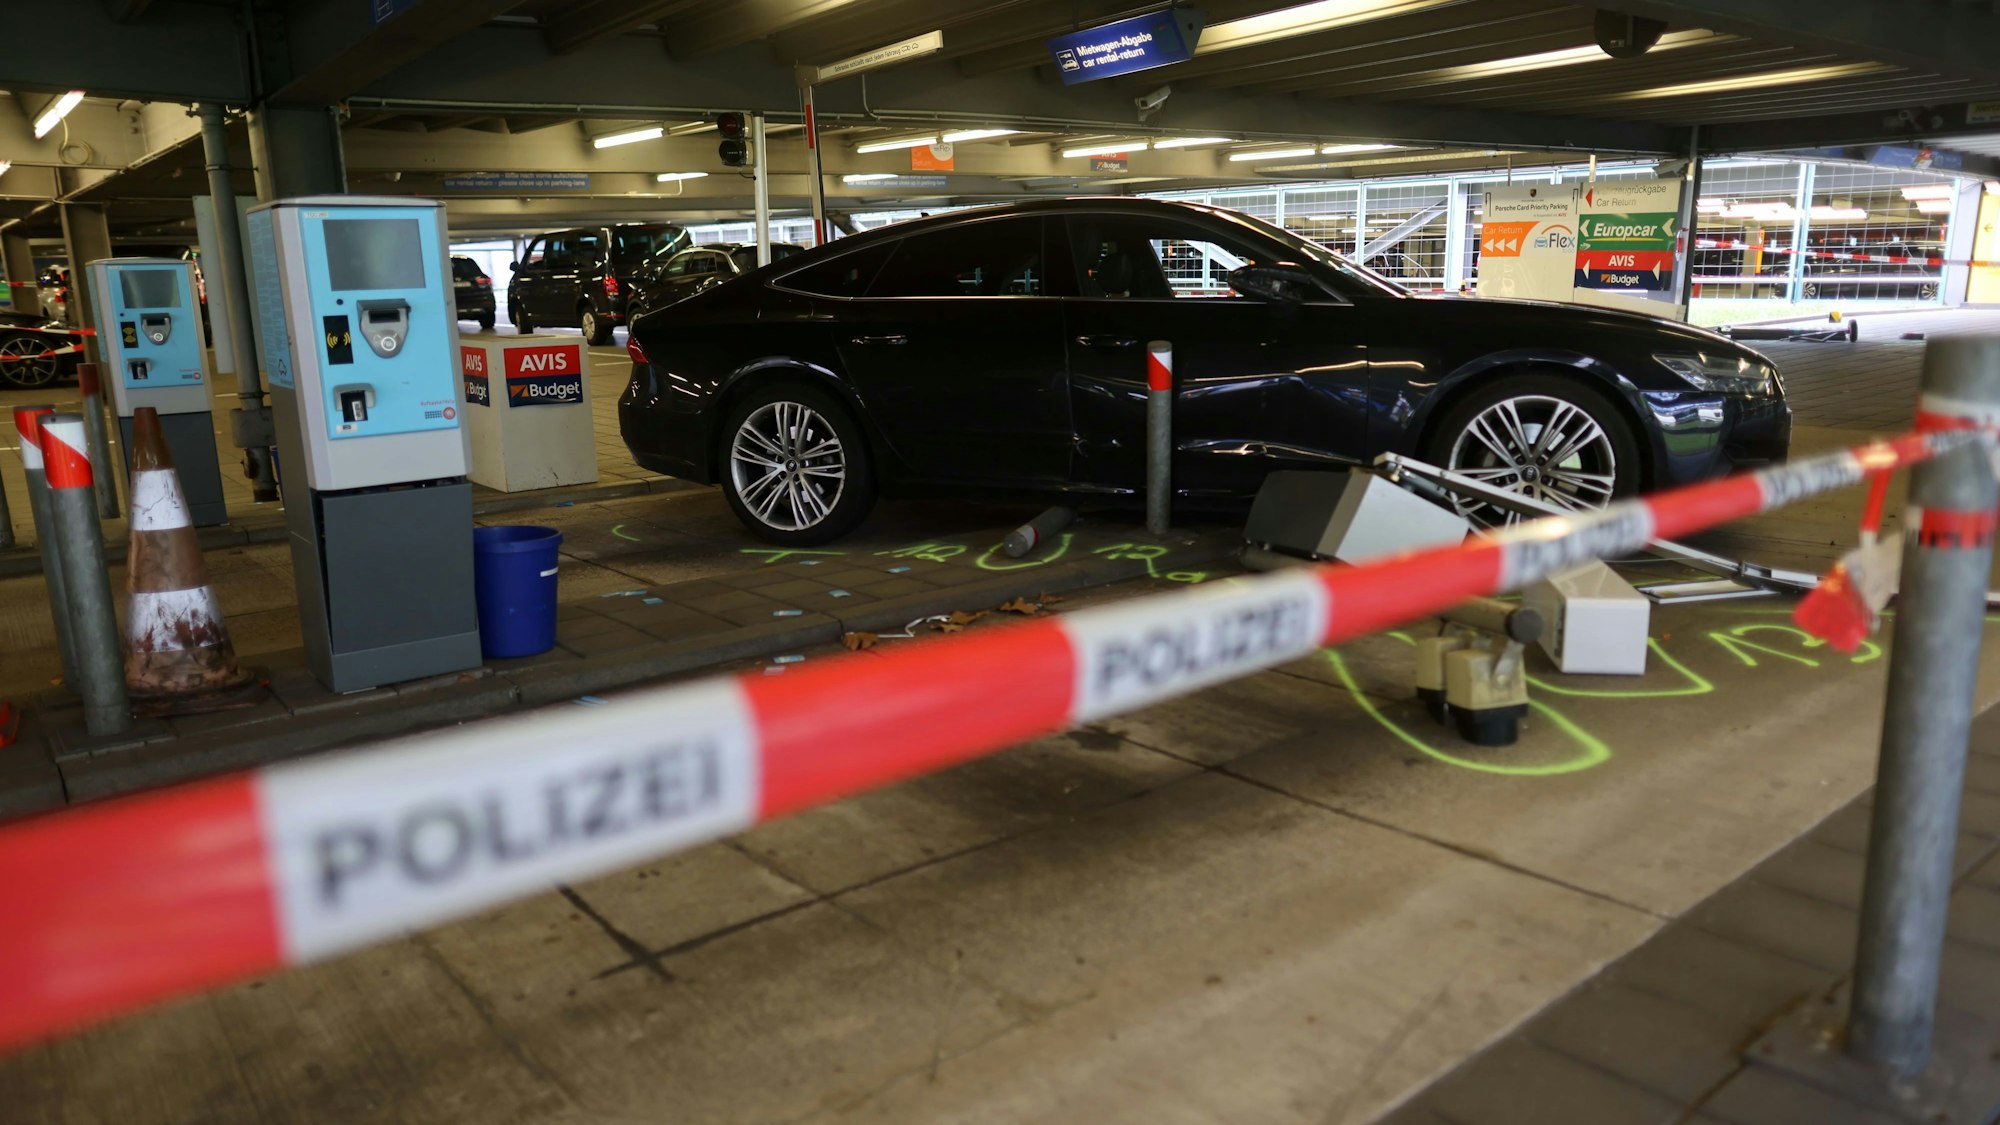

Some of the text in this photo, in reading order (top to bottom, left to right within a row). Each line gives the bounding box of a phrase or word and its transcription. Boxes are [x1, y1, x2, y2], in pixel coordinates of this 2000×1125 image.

[1076, 32, 1153, 56] Mietwagen-Abgabe
[884, 48, 901, 58] Fahrzeug
[1082, 47, 1146, 68] car rental-return
[1104, 162, 1120, 170] Budget
[1530, 203, 1549, 212] Priority
[1550, 203, 1568, 211] Parking
[1596, 197, 1637, 207] Car Return
[1498, 226, 1523, 234] Return
[1593, 223, 1658, 241] Europcar
[1549, 232, 1575, 248] Flex
[1608, 255, 1635, 267] AVIS
[1611, 274, 1639, 286] Budget
[465, 353, 482, 372] AVIS
[519, 352, 567, 372] AVIS
[529, 381, 580, 399] Budget
[1094, 592, 1314, 695] POLIZEI
[315, 736, 724, 907] POLIZEI
